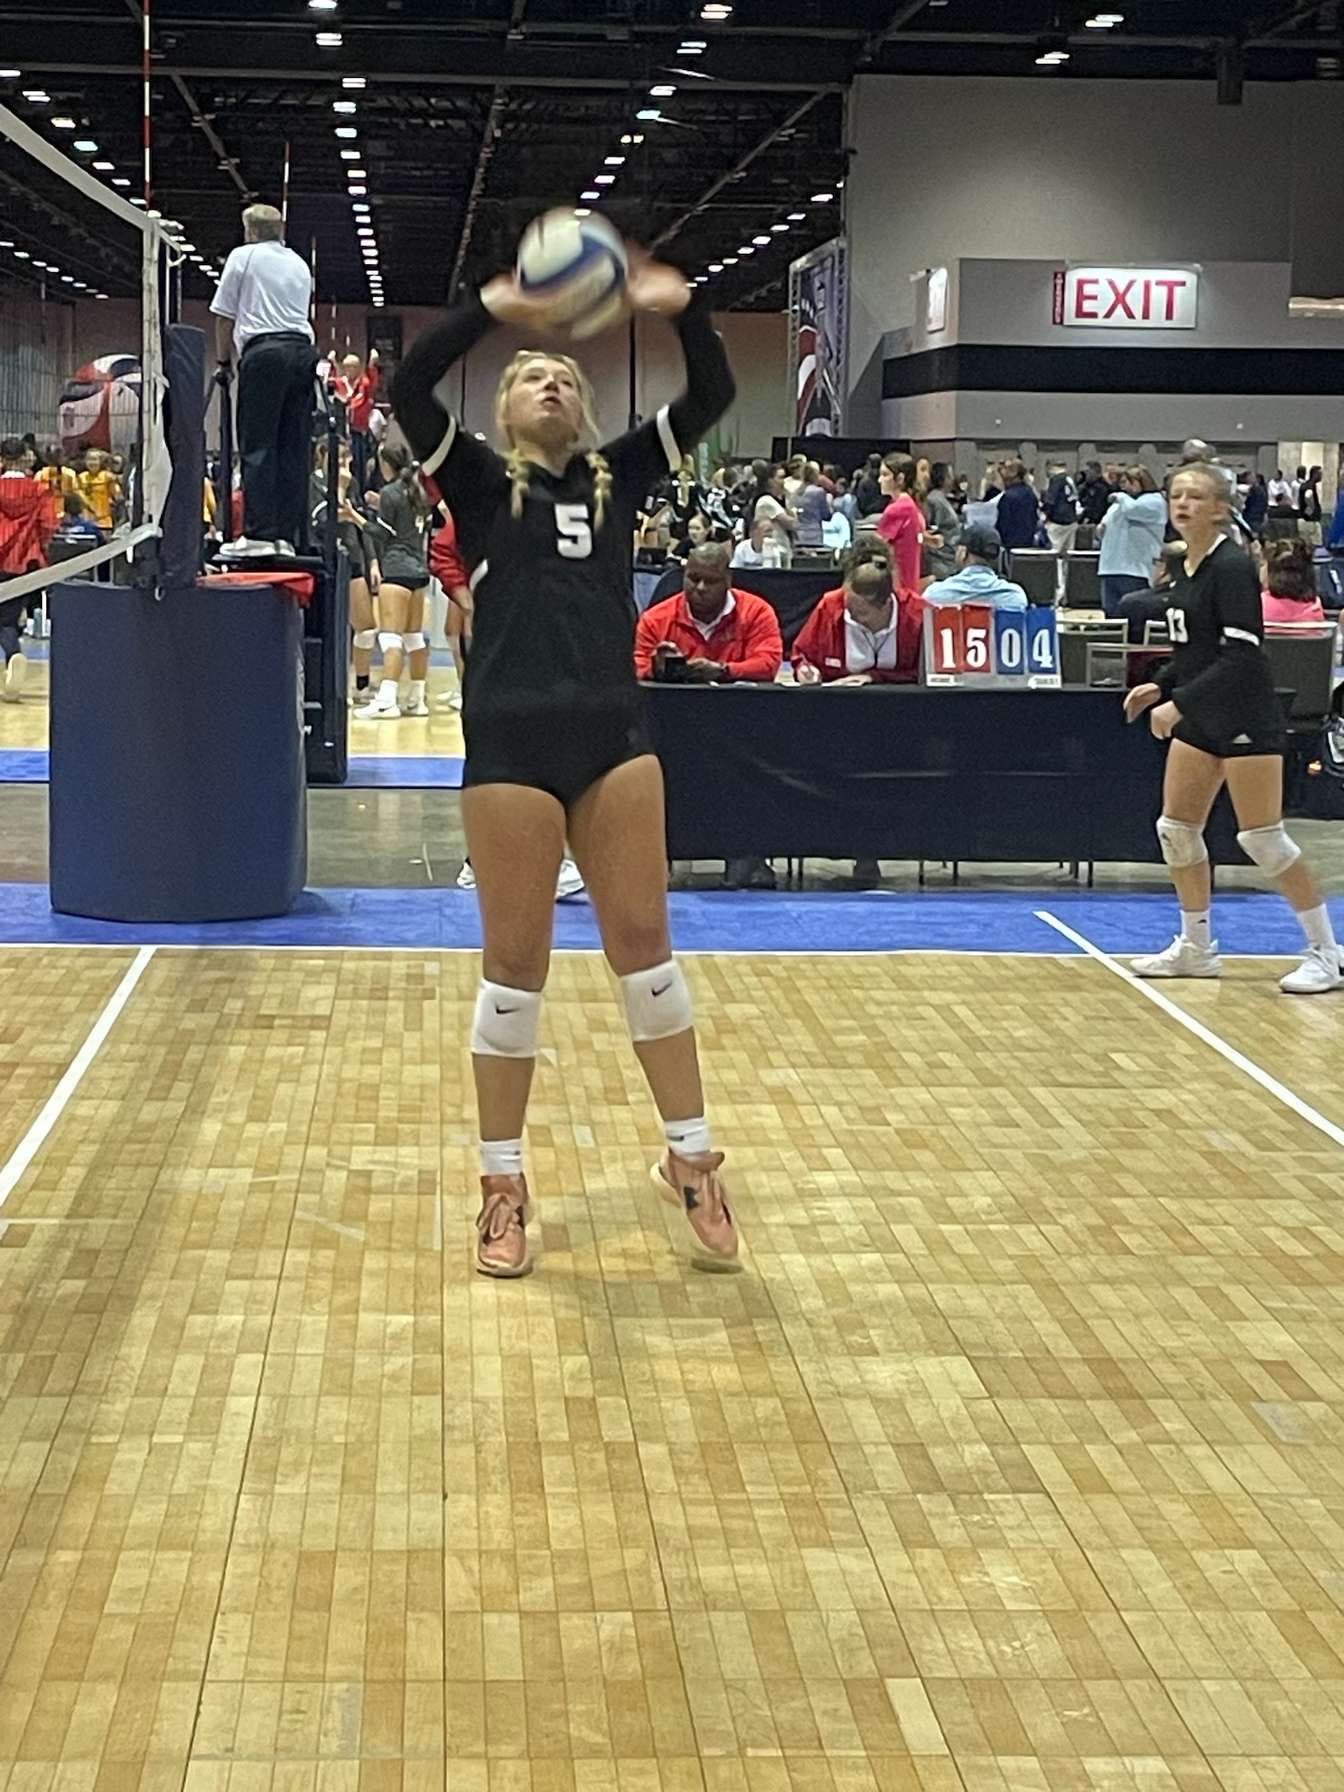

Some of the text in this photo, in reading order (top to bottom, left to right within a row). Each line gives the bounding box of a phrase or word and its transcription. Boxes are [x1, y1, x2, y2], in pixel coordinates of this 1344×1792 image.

[1074, 279, 1186, 321] EXIT
[554, 503, 593, 559] 5
[1165, 607, 1189, 643] 13
